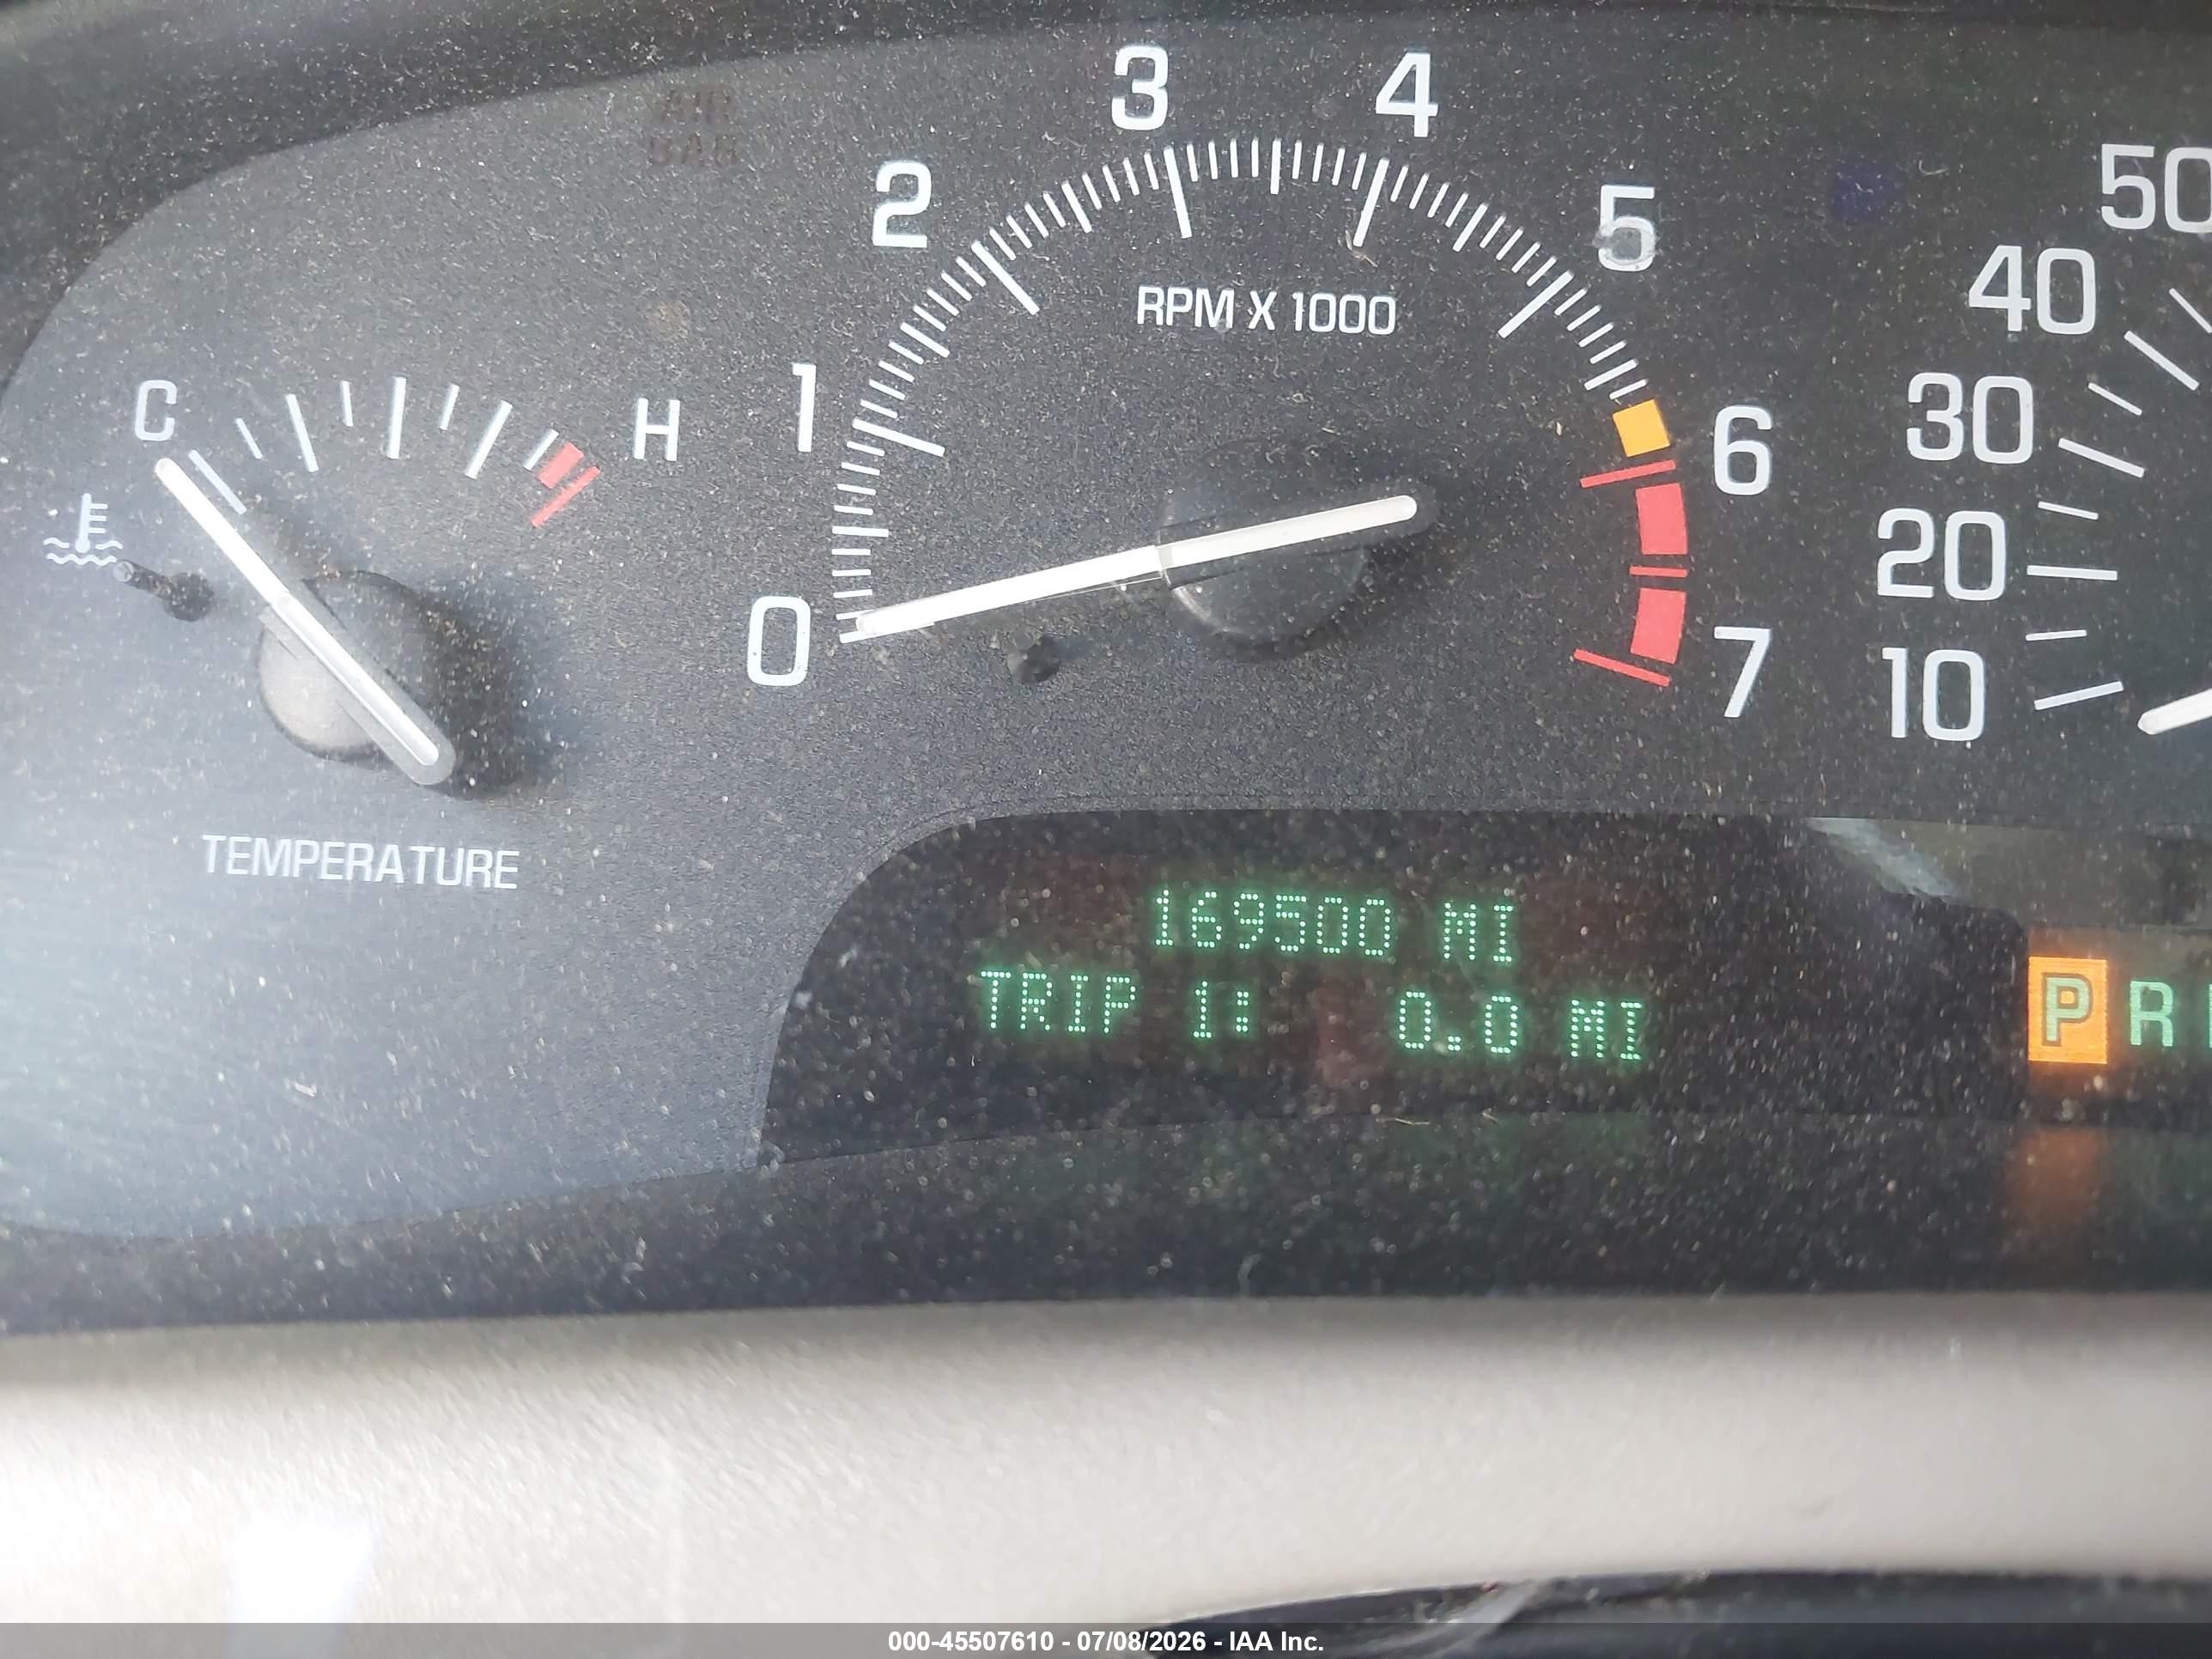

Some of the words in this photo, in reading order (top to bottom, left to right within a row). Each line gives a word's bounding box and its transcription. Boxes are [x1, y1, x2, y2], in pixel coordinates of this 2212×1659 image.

[1112, 45, 1169, 131] 3
[1375, 52, 1438, 137] 4
[872, 161, 932, 248] 2
[1597, 185, 1656, 271] 5
[2101, 143, 2212, 234] 50
[1137, 286, 1234, 329] RPM
[1248, 290, 1277, 330] X
[1292, 293, 1397, 335] 1000
[1968, 245, 2096, 335] 40
[135, 380, 177, 441] C
[633, 398, 681, 461] H
[792, 363, 817, 453] 1
[1714, 405, 1773, 495] 6
[1906, 372, 2034, 465] 30
[1876, 507, 2007, 601] 20
[747, 596, 811, 687] 0
[1714, 627, 1772, 719] 7
[1881, 647, 1986, 742] 10
[202, 834, 521, 890] TEMPERATURE
[1154, 889, 1395, 957] 169500
[1443, 900, 1516, 963] MI
[979, 970, 1137, 1035] TRIP
[1193, 980, 1250, 1040] 1:
[1397, 991, 1520, 1055] 0.0
[1569, 1000, 1644, 1062] MI
[2041, 972, 2092, 1046] P
[2130, 980, 2174, 1047] R
